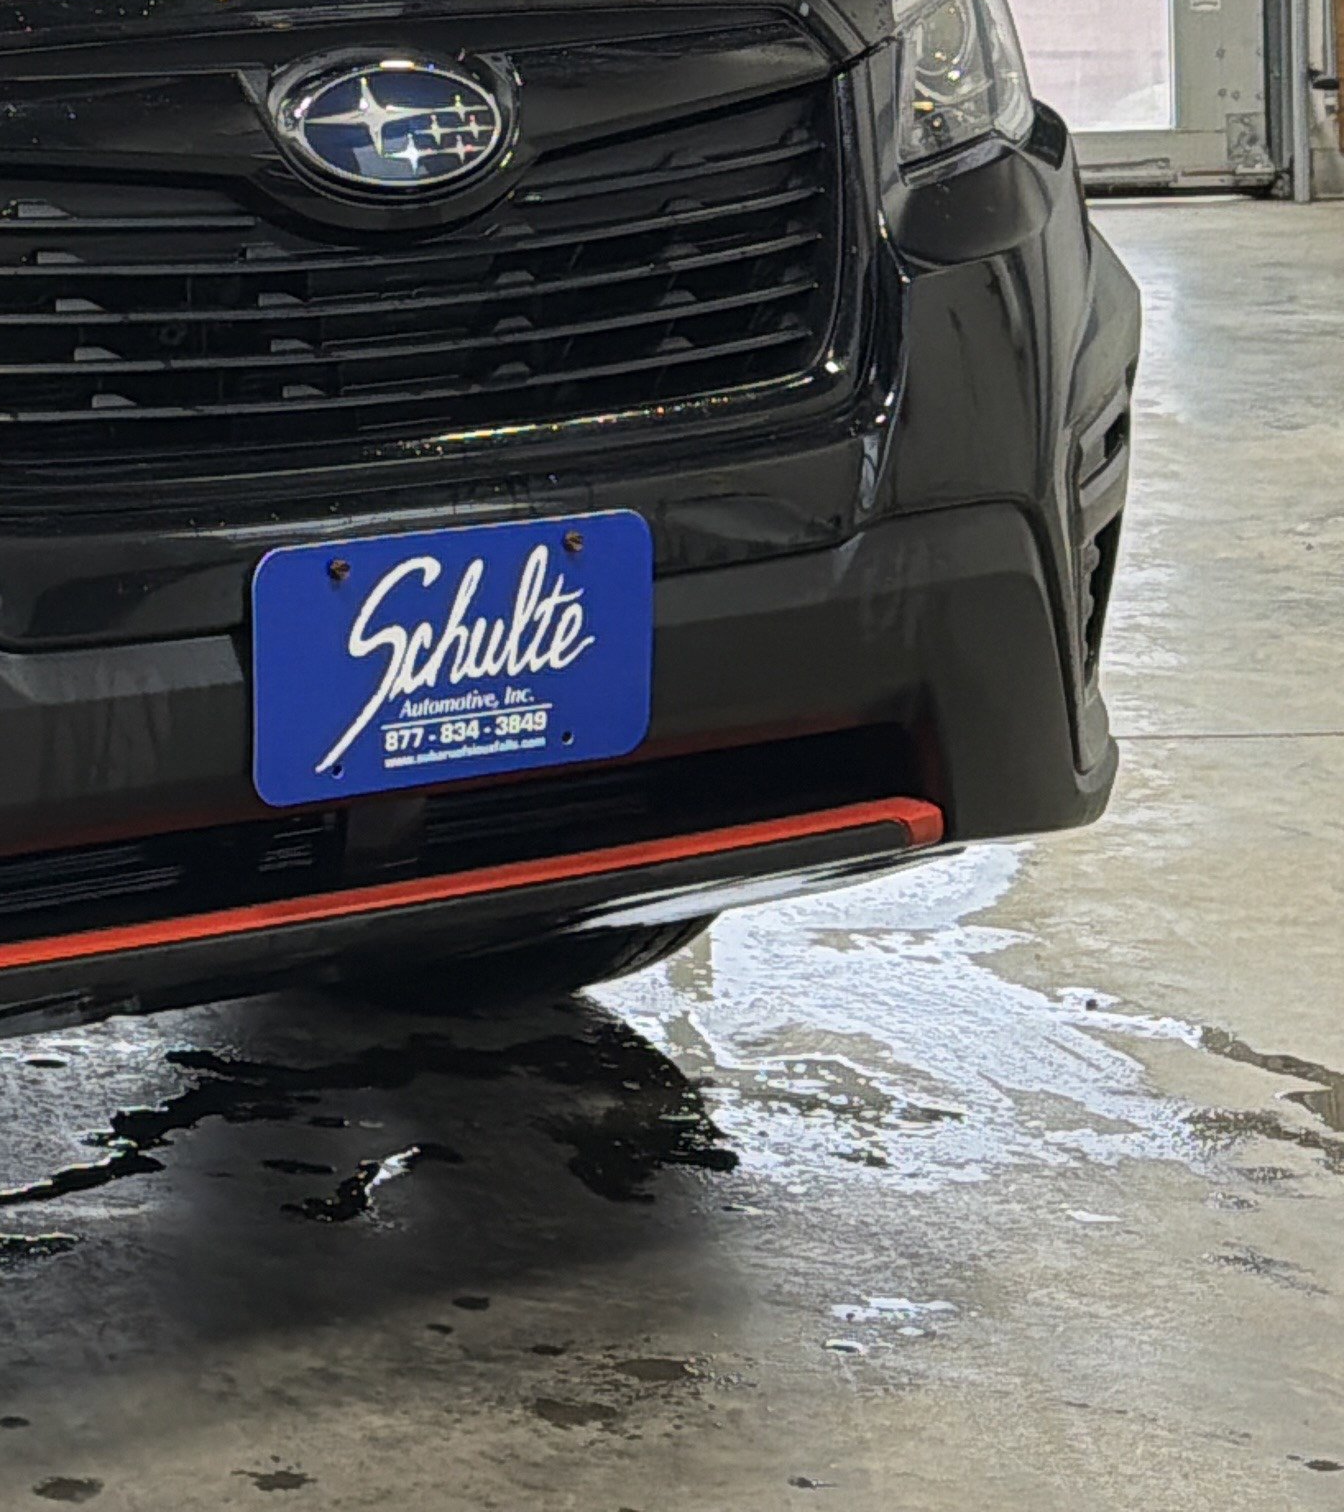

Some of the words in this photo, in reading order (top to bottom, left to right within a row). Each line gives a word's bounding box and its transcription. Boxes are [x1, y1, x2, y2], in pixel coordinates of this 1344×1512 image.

[315, 543, 596, 774] Schulte
[399, 689, 499, 718] Automotive,
[504, 686, 535, 705] Inc.
